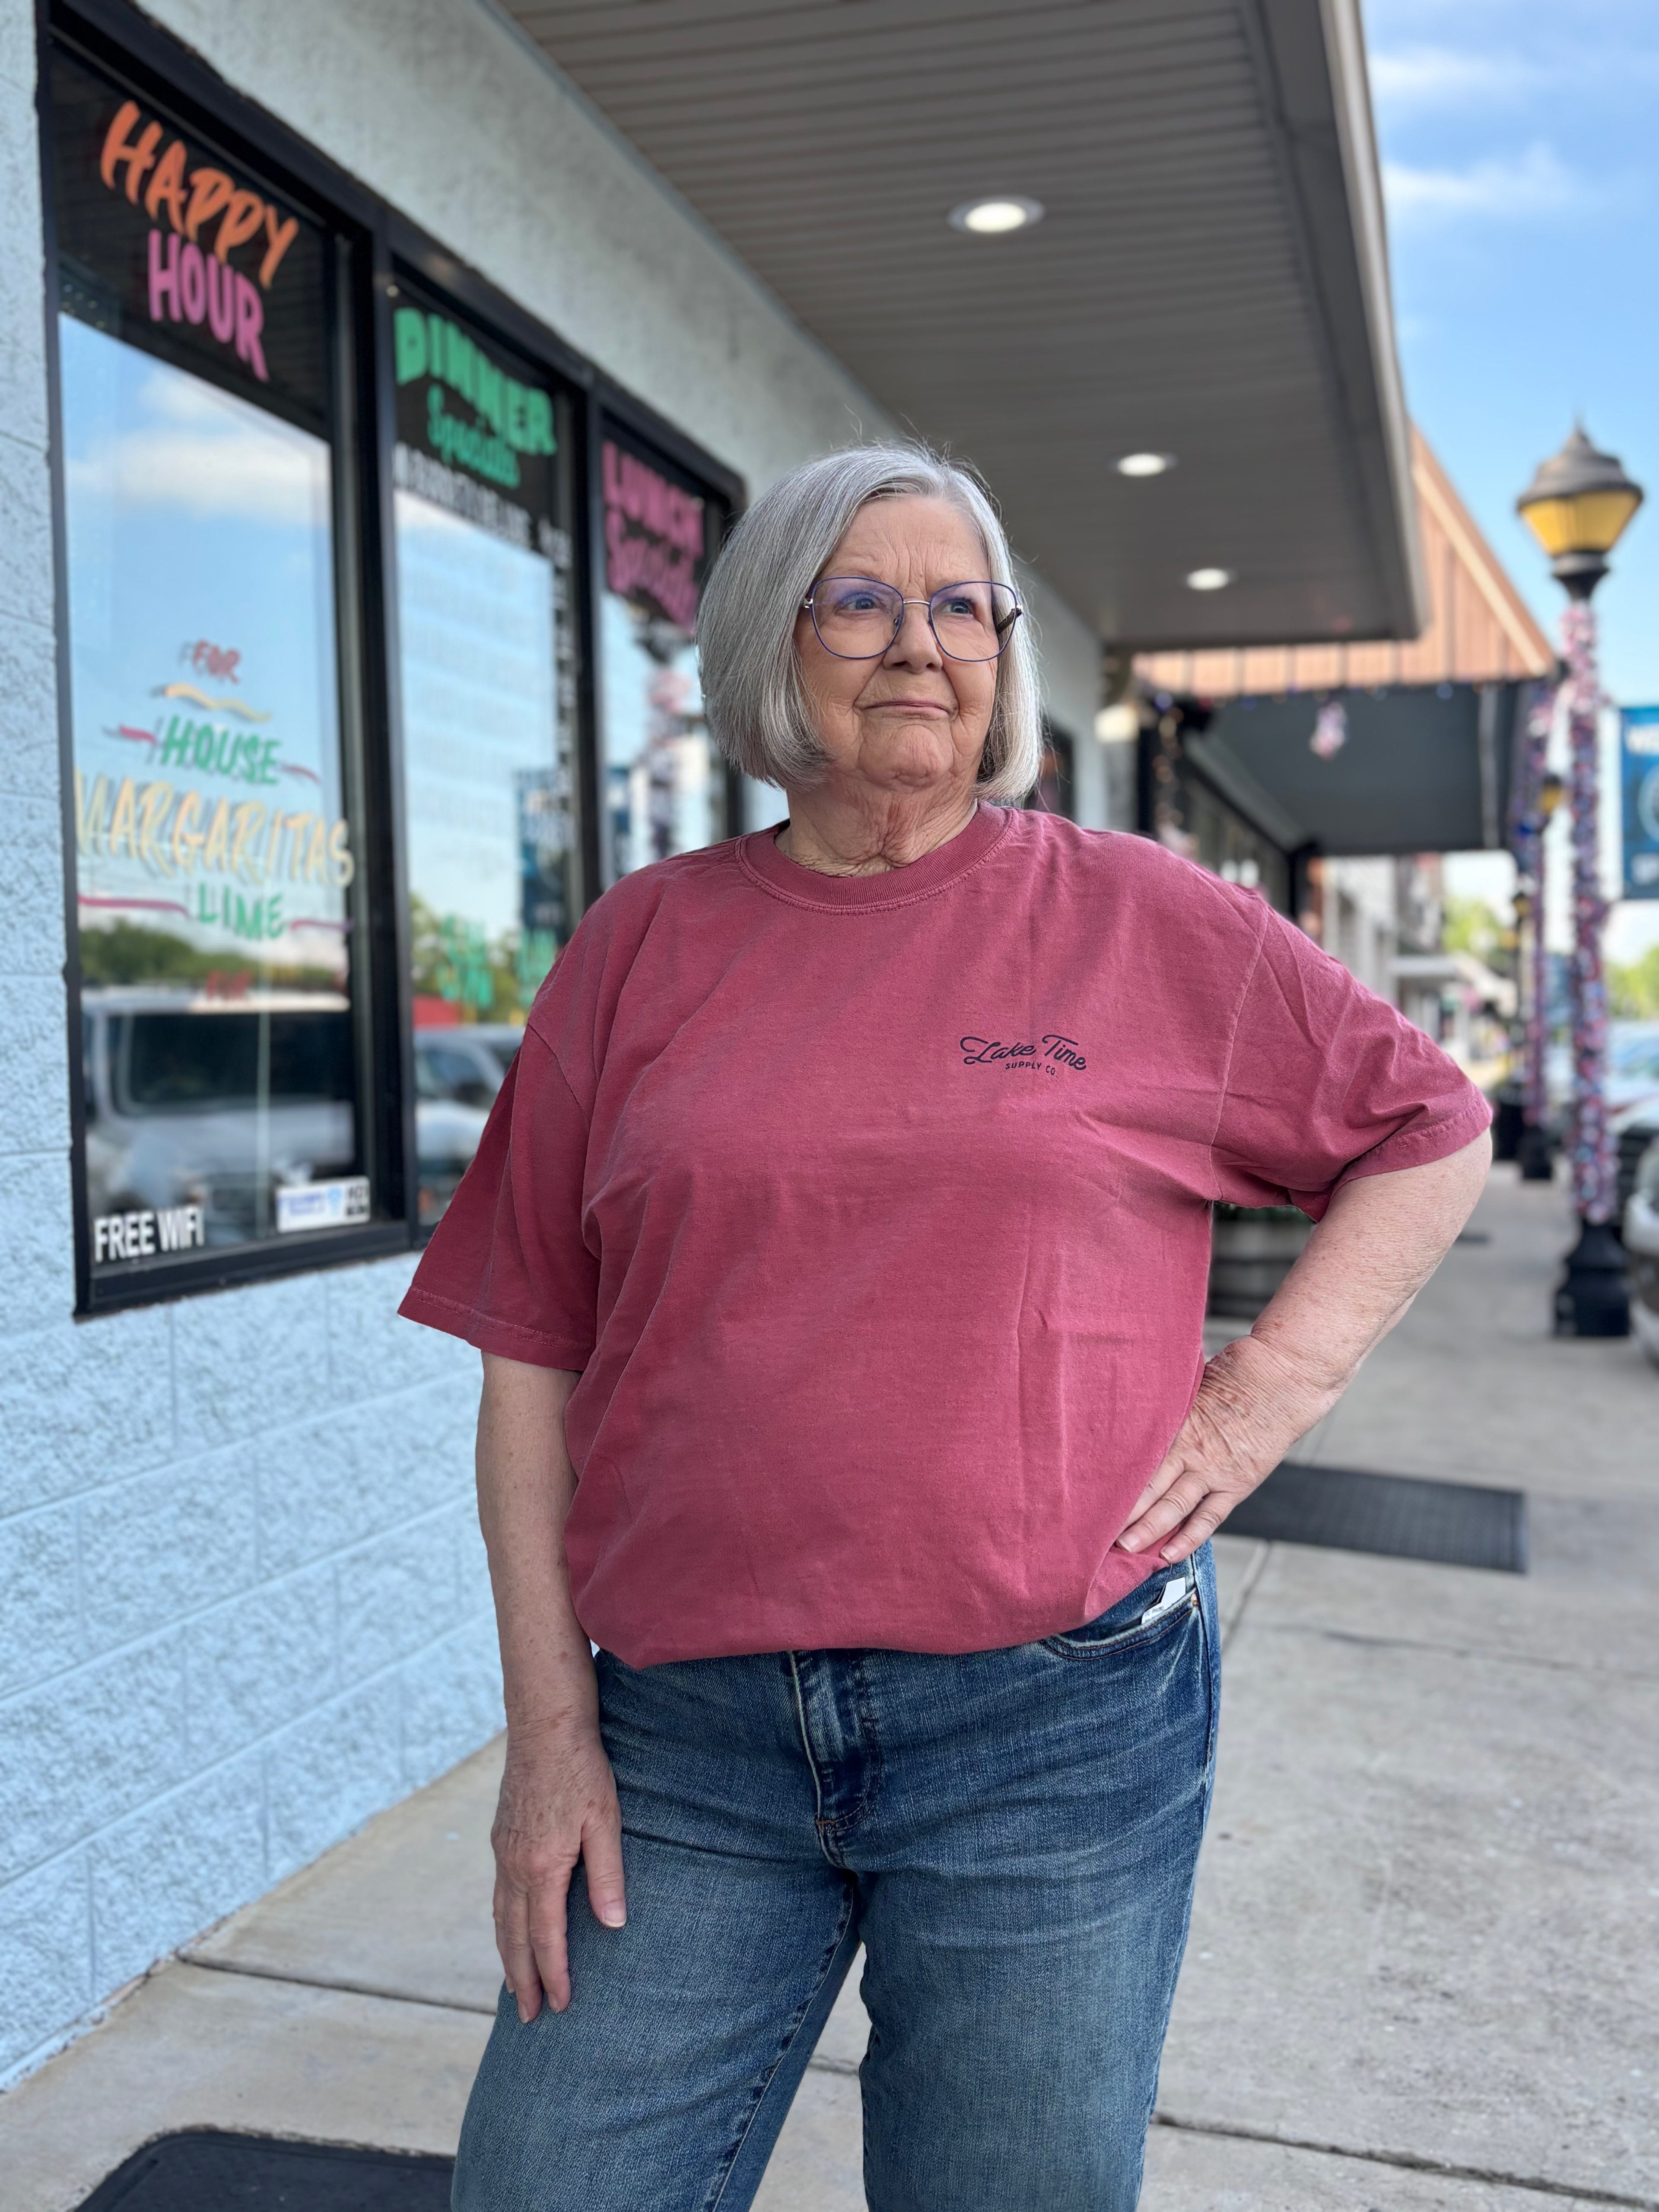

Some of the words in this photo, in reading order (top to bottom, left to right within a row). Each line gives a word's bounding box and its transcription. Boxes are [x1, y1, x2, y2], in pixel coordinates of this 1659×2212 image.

[100, 100, 299, 290] HAPPY
[148, 229, 269, 382] HOUR
[394, 307, 557, 456] DINNER
[161, 715, 283, 784] HOUSE
[73, 766, 355, 888] MARGARITAS
[198, 881, 284, 941] LIME
[960, 1036, 1036, 1064] Lake
[1042, 1035, 1086, 1070] Time
[1005, 1061, 1042, 1070] SUPPLY
[1046, 1065, 1055, 1075] CO
[94, 1210, 156, 1263] FREE
